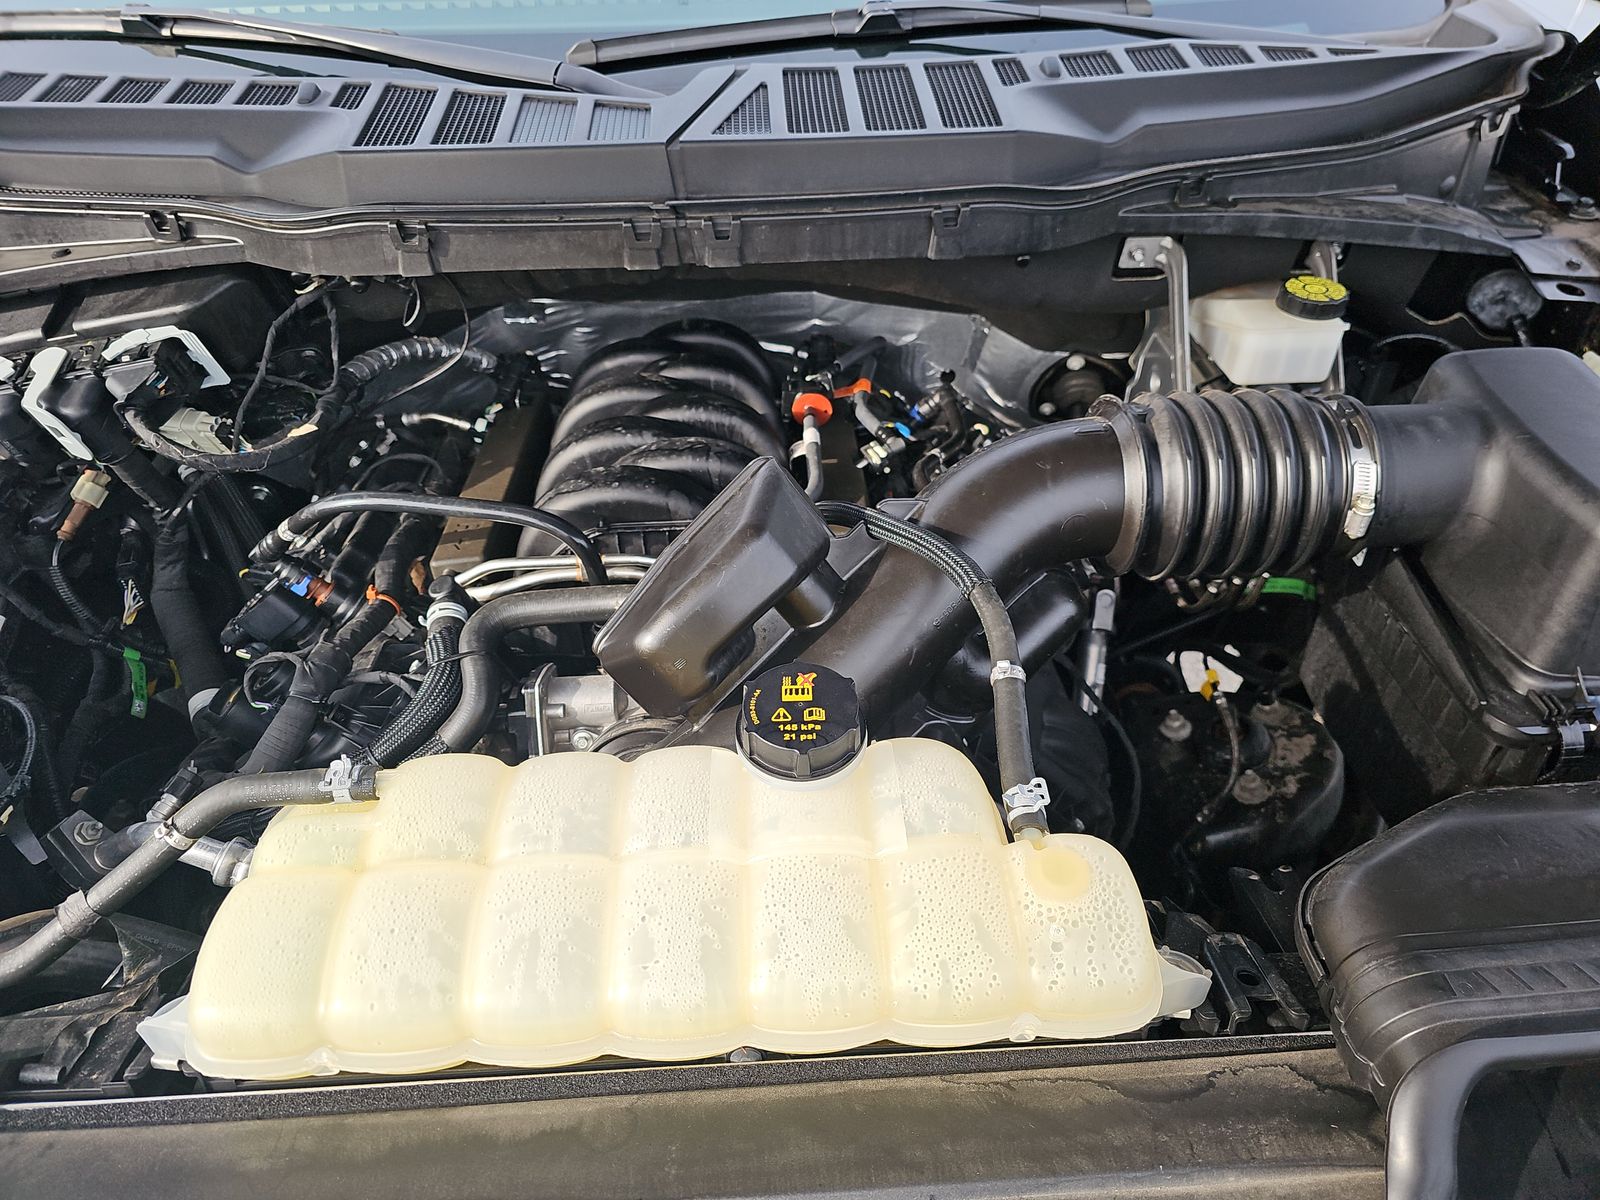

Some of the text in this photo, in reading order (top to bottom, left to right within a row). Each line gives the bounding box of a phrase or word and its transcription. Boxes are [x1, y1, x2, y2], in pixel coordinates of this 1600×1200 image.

[801, 723, 822, 731] kPa
[783, 732, 817, 742] 21 psi
